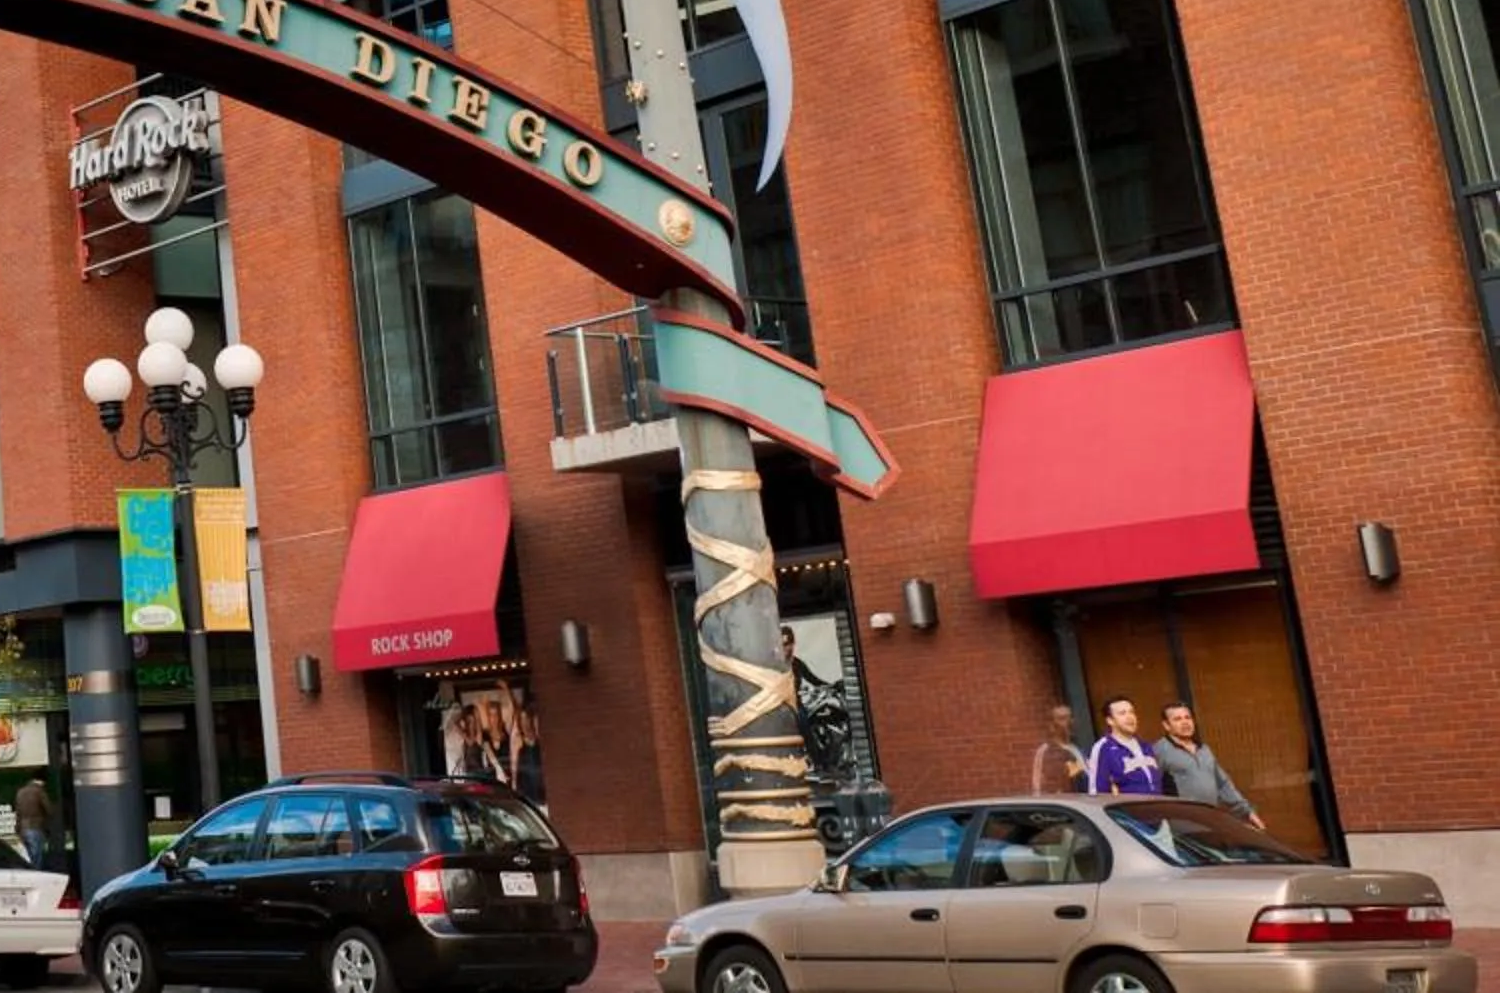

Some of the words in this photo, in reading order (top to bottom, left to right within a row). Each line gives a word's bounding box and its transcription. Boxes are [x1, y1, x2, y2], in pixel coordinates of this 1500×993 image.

[352, 32, 603, 188] DIEGO
[69, 121, 133, 191] Hard
[134, 98, 210, 167] Rock
[117, 176, 165, 204] HOTEL
[371, 634, 410, 656] ROCK
[413, 628, 453, 650] SHOP
